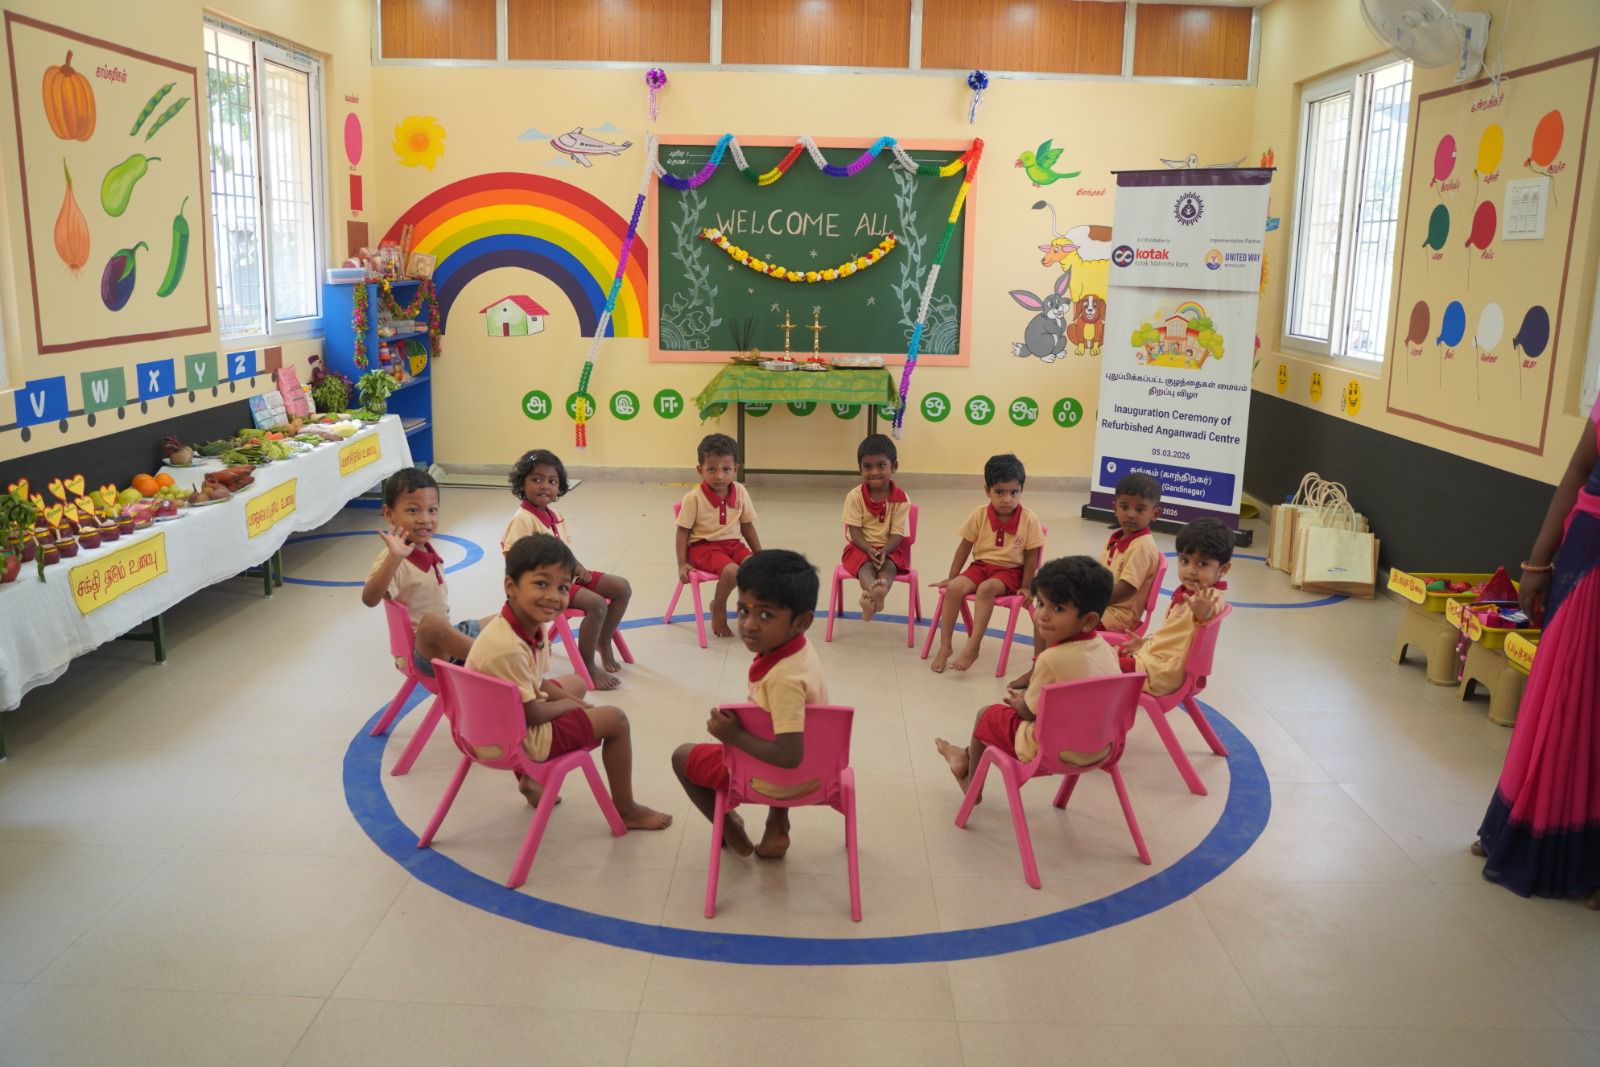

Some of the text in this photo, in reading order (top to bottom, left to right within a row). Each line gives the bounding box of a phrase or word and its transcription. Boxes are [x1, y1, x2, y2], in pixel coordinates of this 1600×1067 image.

[715, 208, 892, 238] WELCOME ALL
[1135, 248, 1169, 260] kotak
[1225, 253, 1260, 262] UNITED WAY
[30, 390, 46, 418] V
[91, 378, 109, 404] W
[149, 370, 161, 393] X
[194, 361, 206, 383] Y
[1165, 378, 1216, 389] குழந்தைகள்
[1217, 382, 1248, 392] மையம்
[1176, 390, 1198, 400] விழா
[526, 397, 547, 414] அ
[615, 394, 634, 415] இ
[660, 396, 678, 413] ஈ
[1114, 404, 1232, 426] Inauguration Ceremony of
[1101, 419, 1241, 445] Refurbished Anganwadi Centre
[1151, 448, 1191, 460] 05.03.2026
[1161, 483, 1206, 497] (Gandinagar)
[1162, 507, 1178, 517] 2026
